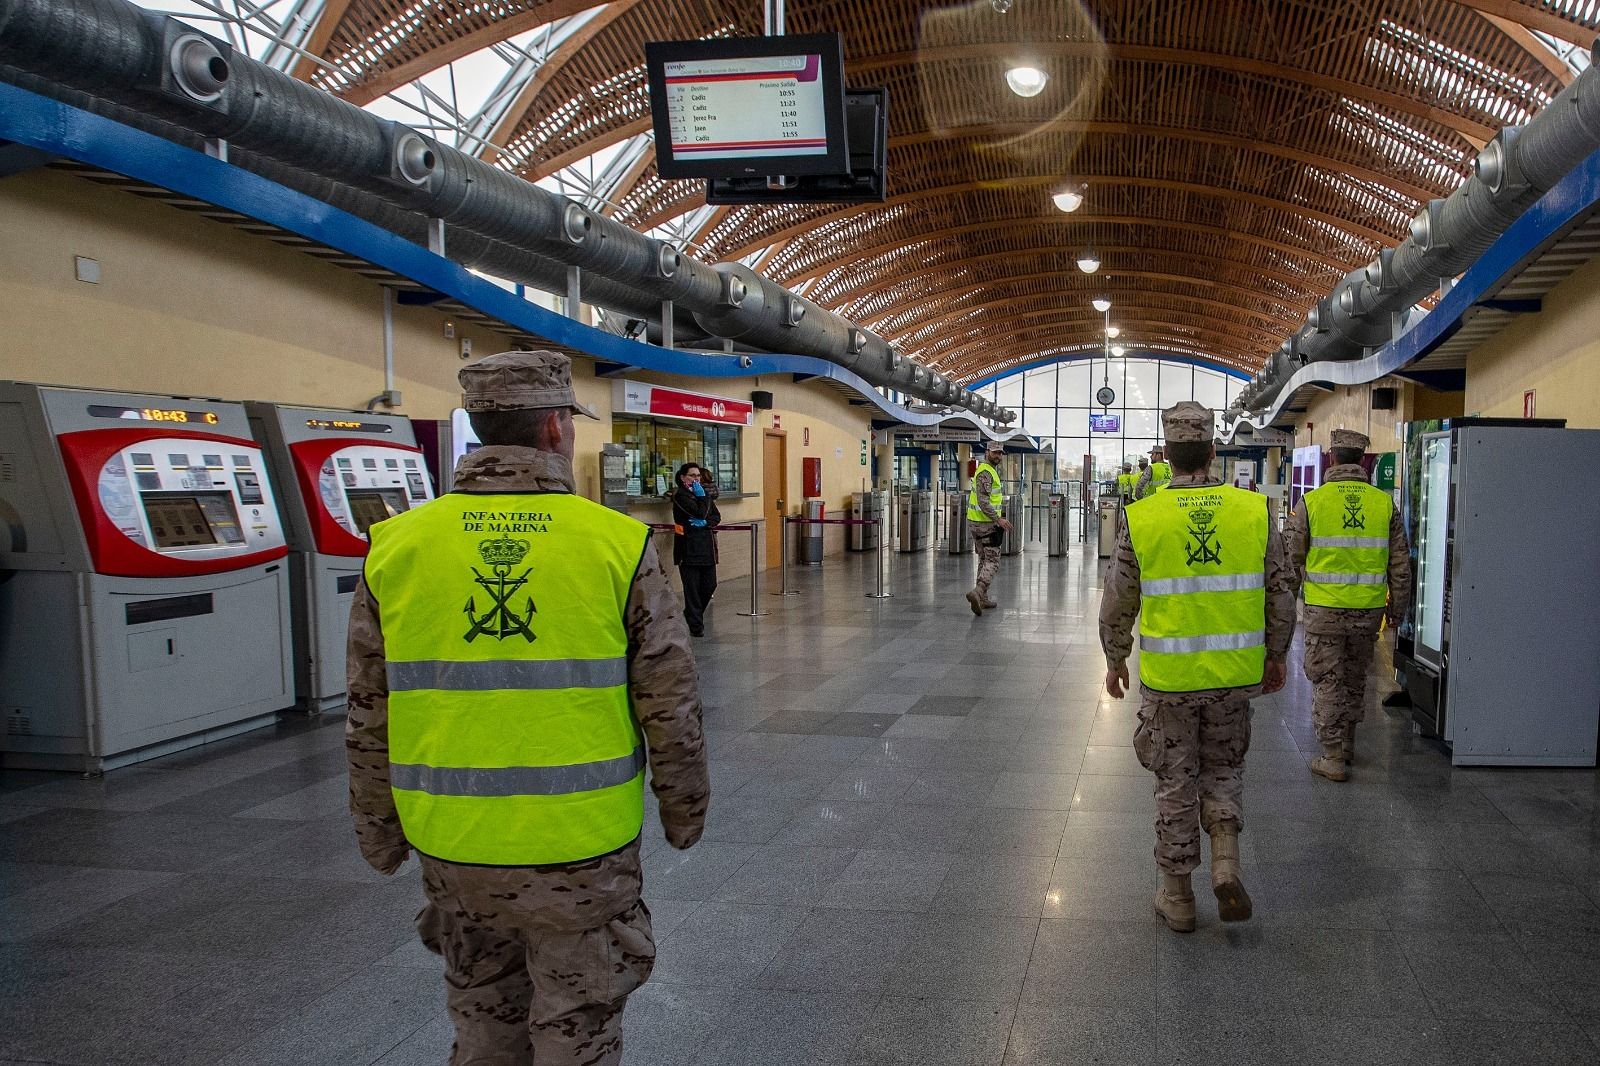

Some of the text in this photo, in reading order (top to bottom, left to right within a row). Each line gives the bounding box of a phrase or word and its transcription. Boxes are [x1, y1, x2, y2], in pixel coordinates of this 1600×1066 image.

[462, 512, 552, 522] INFANTERIA
[464, 522, 548, 532] DE MARINA
